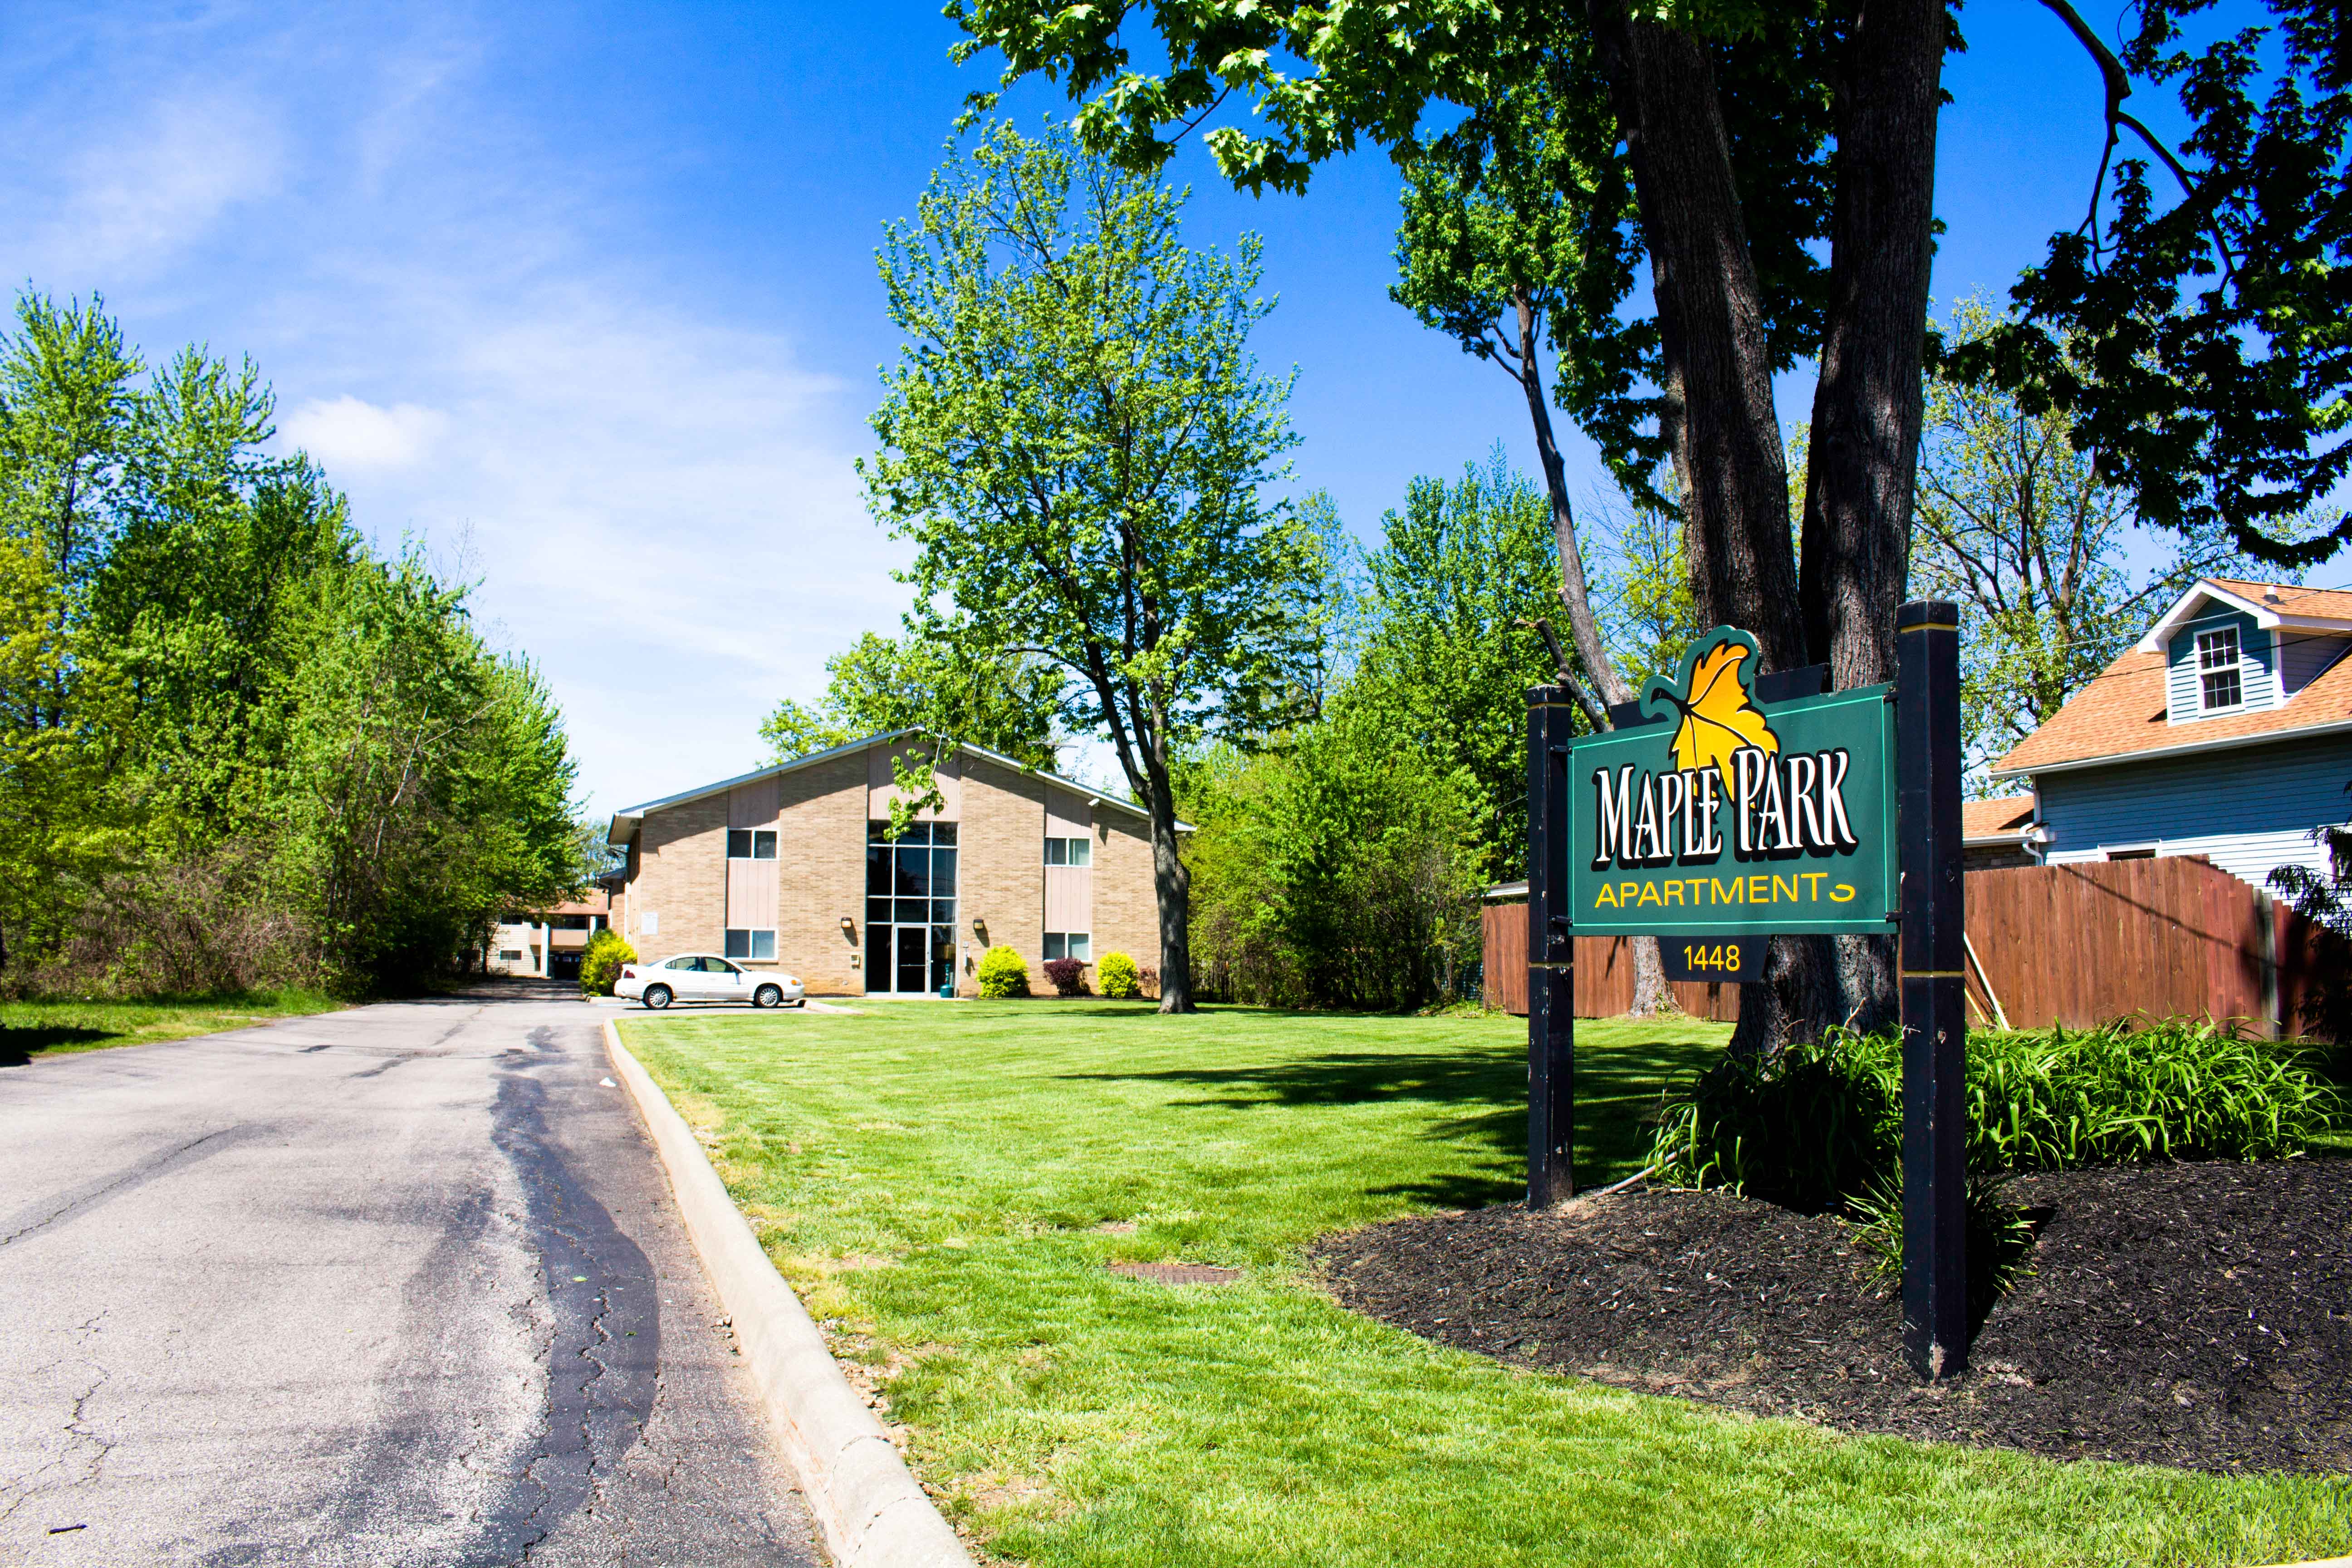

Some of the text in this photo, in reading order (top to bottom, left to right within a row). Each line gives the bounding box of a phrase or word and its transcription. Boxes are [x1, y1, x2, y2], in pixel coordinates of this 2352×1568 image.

[1595, 748, 1857, 862] MAPLE PARK
[1684, 945, 1741, 972] 1448
